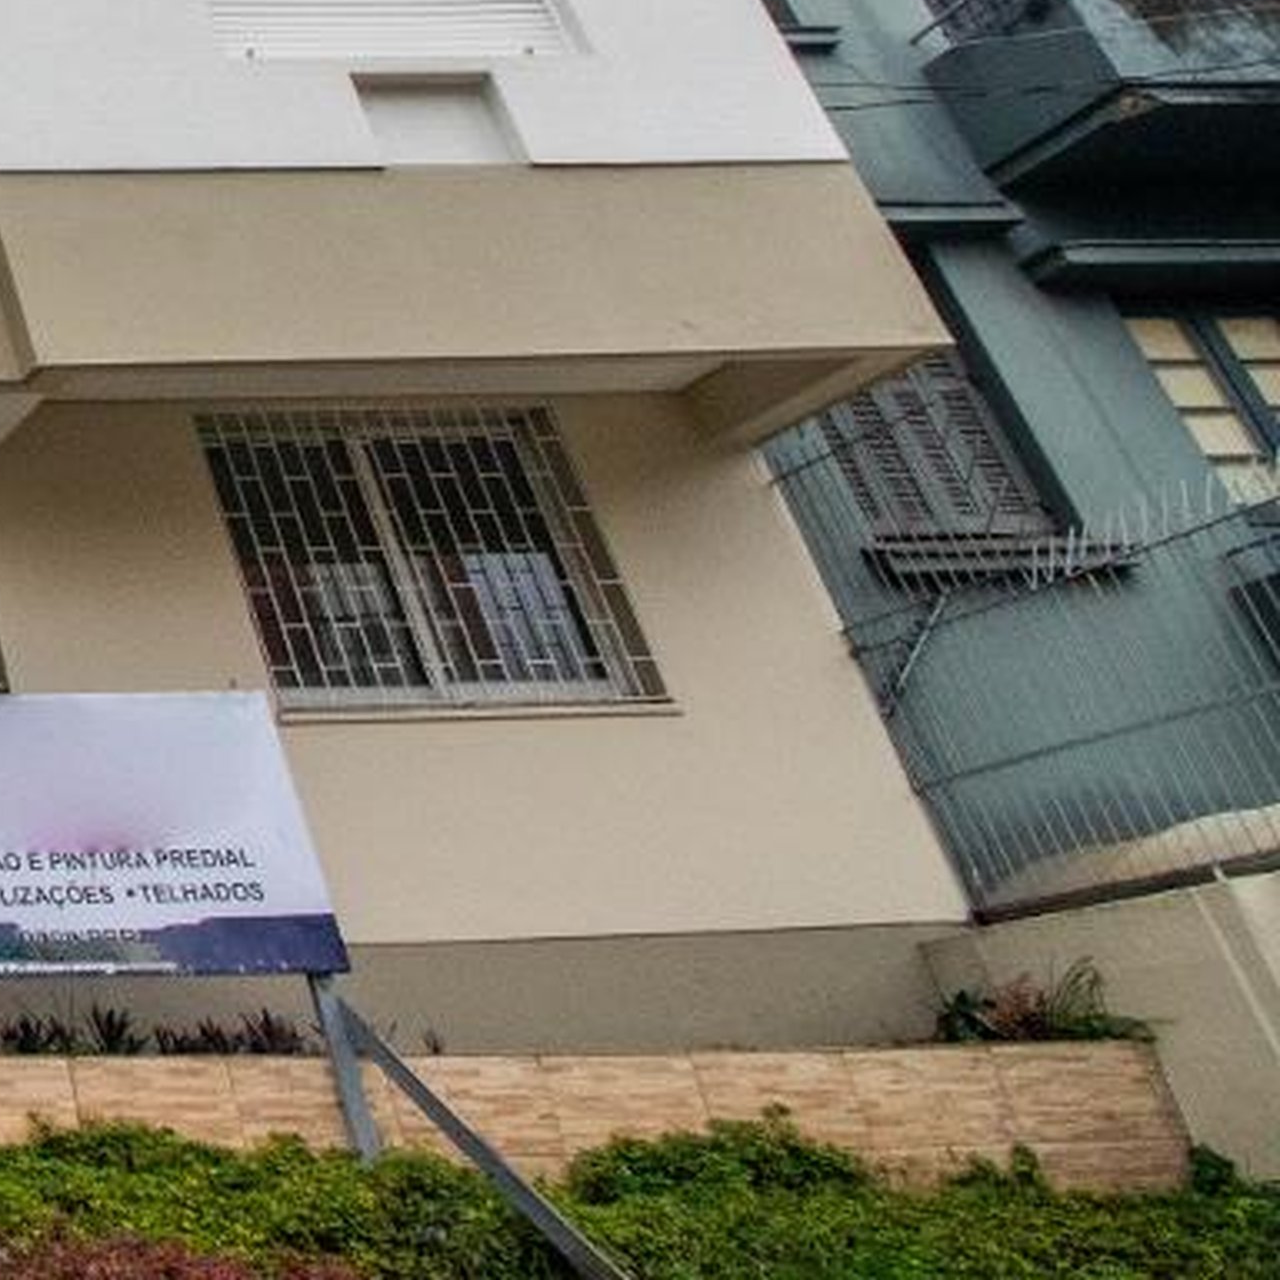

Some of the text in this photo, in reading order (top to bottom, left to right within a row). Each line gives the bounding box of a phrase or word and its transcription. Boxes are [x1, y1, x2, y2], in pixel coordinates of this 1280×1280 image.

[29, 852, 43, 871] E
[49, 851, 150, 872] PINTURA
[155, 848, 255, 869] PREDIAL
[140, 882, 265, 904] TELHADOS
